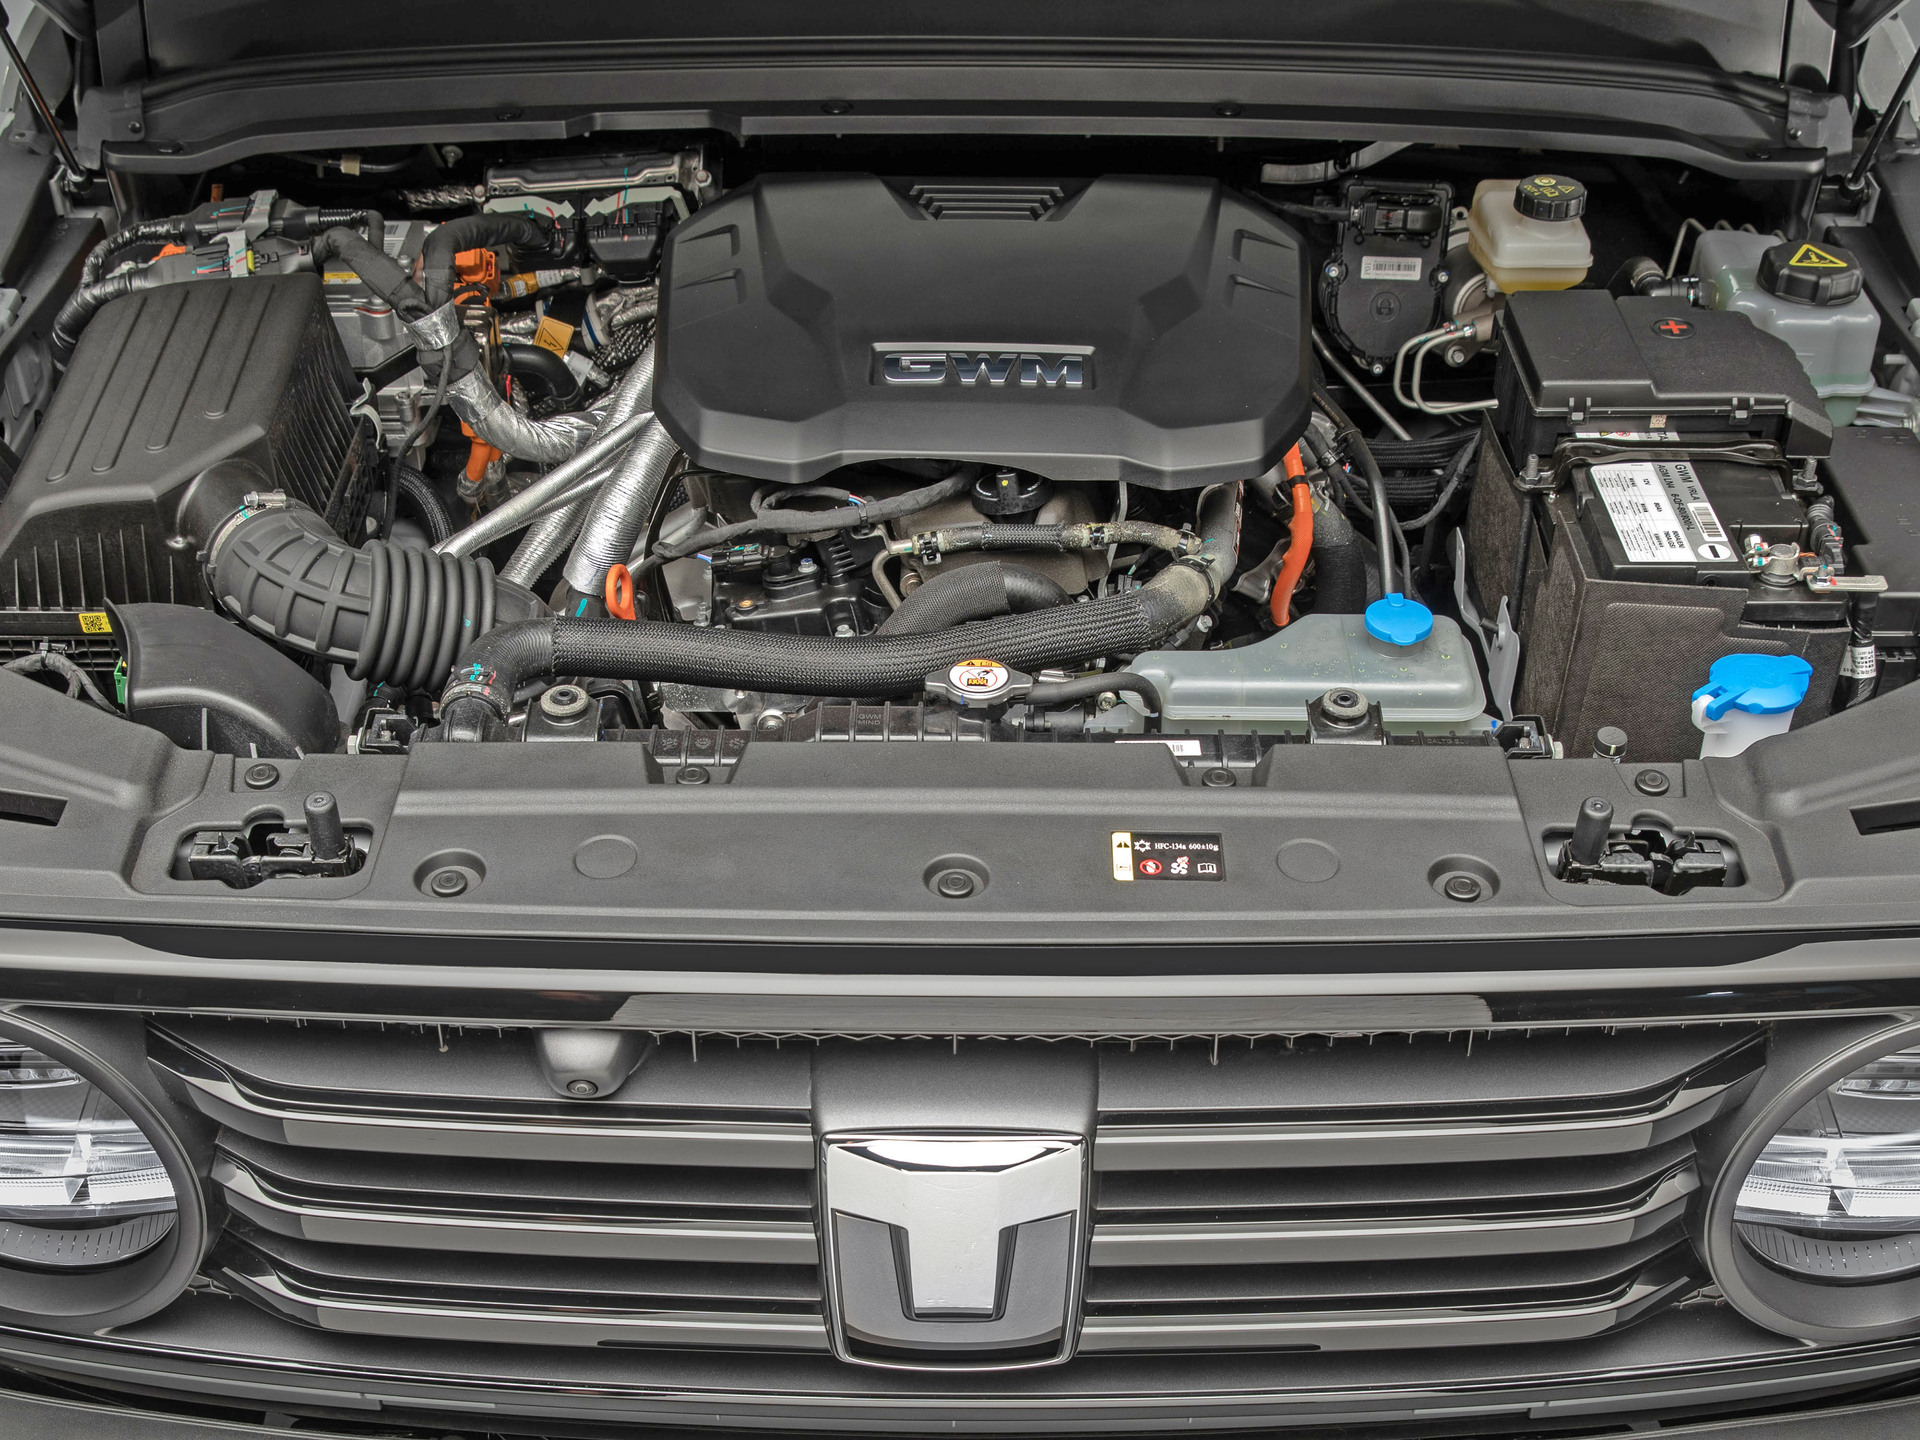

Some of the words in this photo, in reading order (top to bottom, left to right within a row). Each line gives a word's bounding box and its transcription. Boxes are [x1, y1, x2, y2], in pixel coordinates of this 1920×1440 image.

[884, 353, 1083, 385] GWM
[1656, 464, 1671, 478] AGM
[1675, 464, 1694, 483] GWM
[1686, 485, 1701, 501] VRLA
